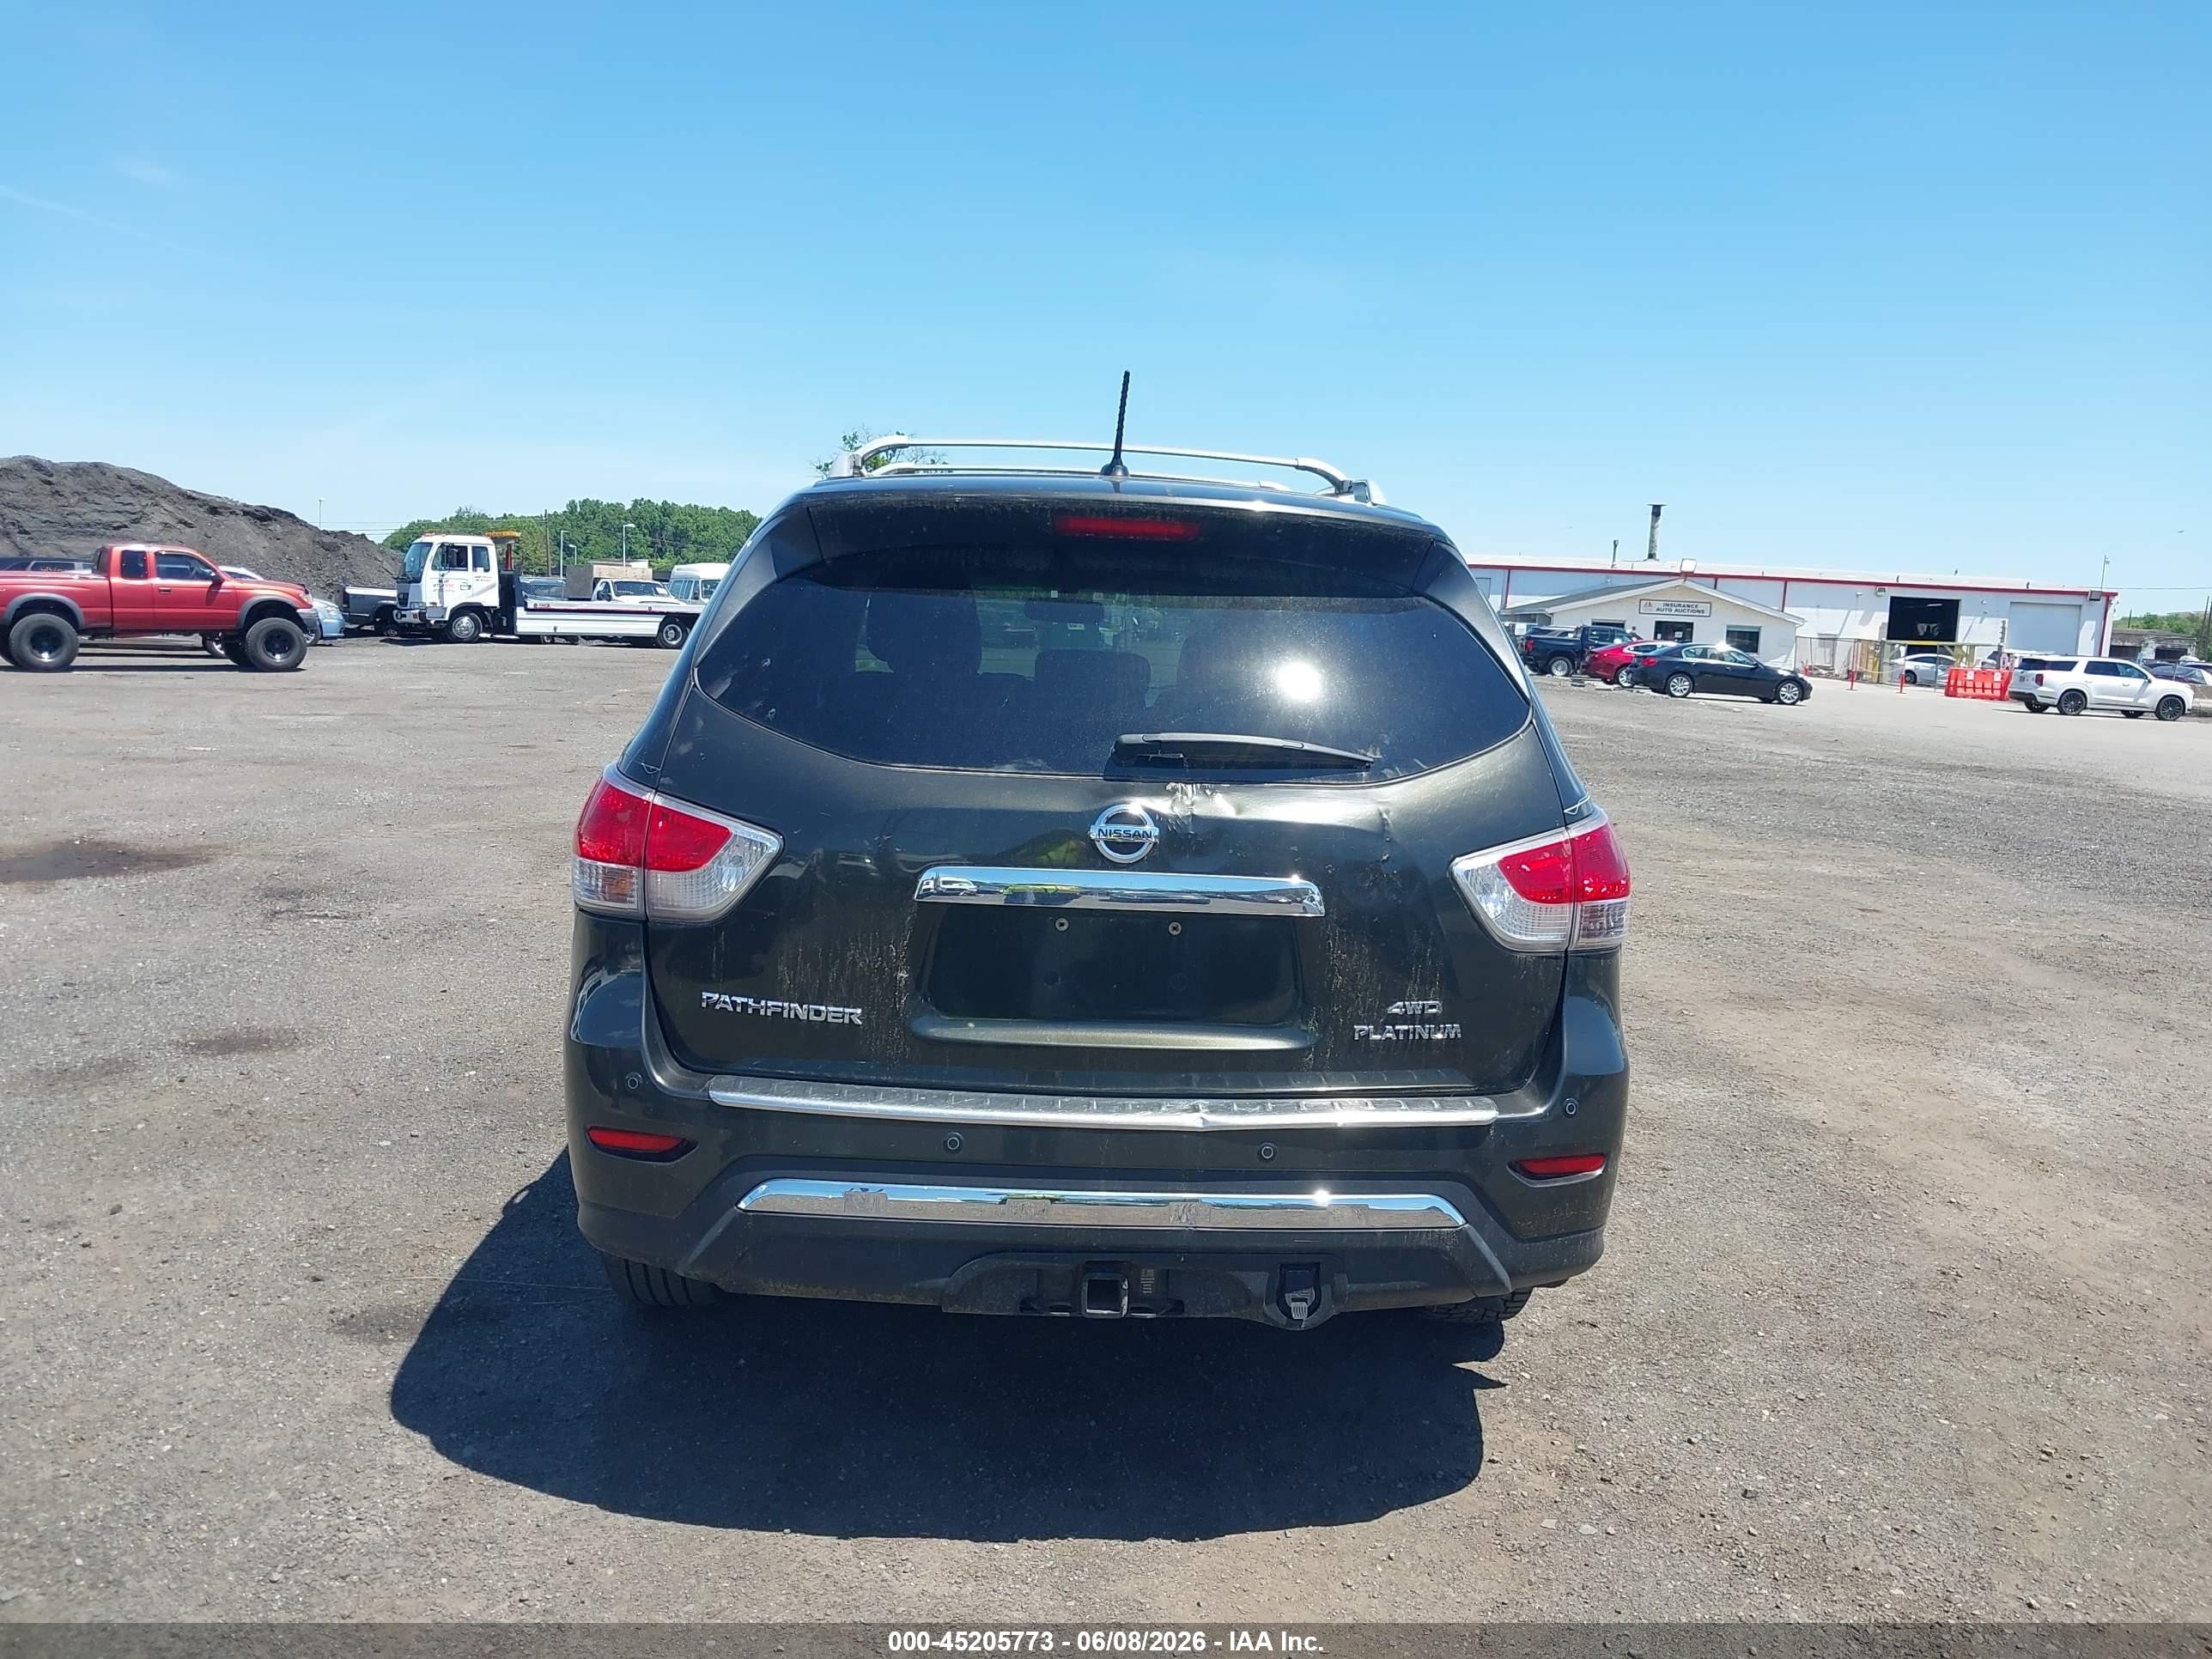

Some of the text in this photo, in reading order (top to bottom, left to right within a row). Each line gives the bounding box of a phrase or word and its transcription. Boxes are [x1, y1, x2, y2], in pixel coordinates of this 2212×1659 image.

[1097, 829, 1152, 838] NISSAN
[701, 992, 862, 1025] PATHFINDER
[1387, 1000, 1443, 1014] 4WD
[1353, 1024, 1462, 1040] PLATINUM
